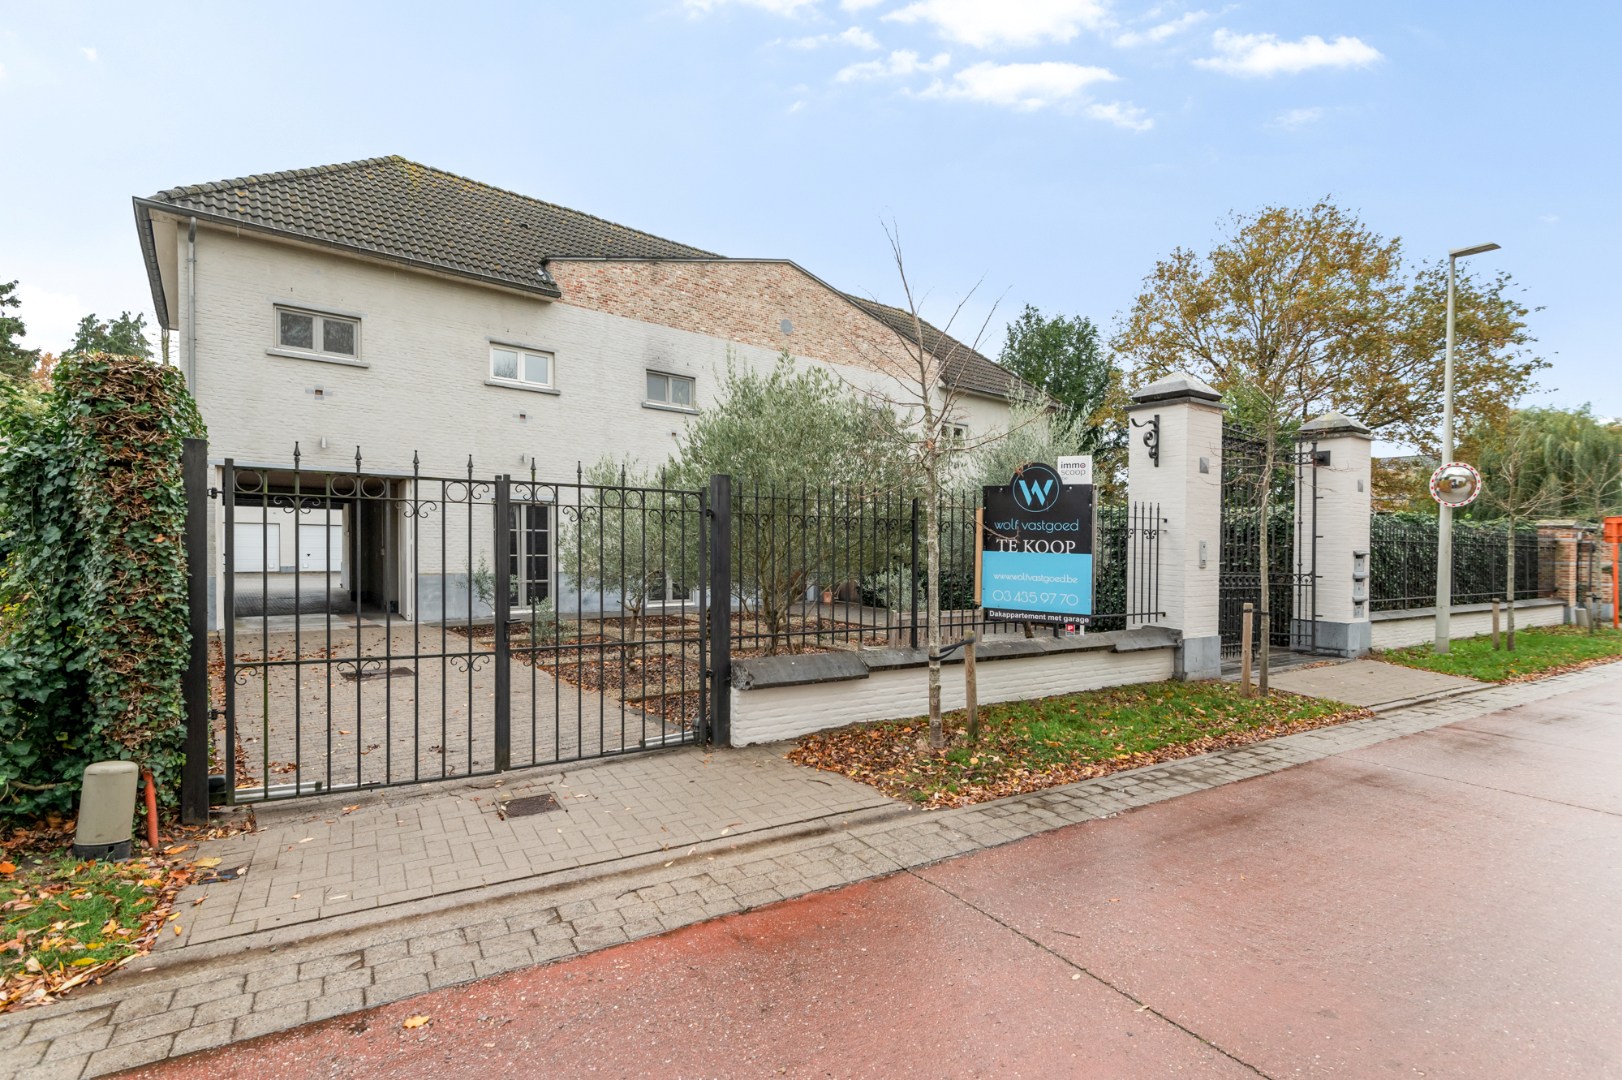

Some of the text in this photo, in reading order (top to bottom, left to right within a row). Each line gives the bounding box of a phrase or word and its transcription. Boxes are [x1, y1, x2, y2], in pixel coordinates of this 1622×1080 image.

[994, 518, 1080, 534] wolf vastgoed
[996, 538, 1076, 554] TE KOOP
[992, 590, 1079, 606] 03 435 97 70
[990, 610, 1046, 621] Dakappartement
[1064, 616, 1090, 624] garage
